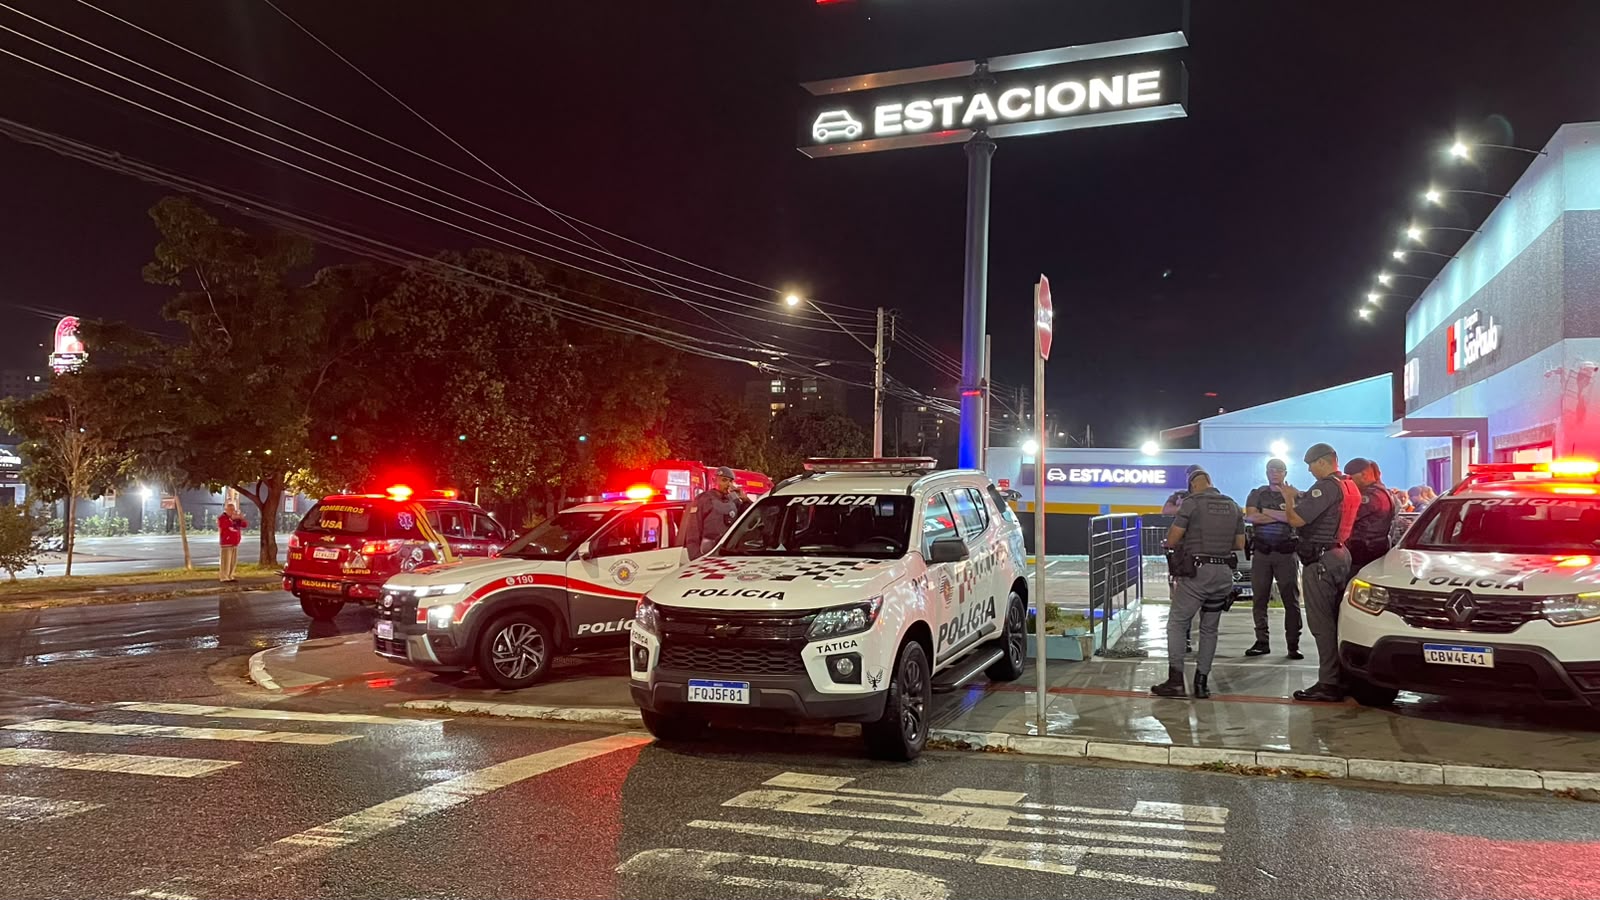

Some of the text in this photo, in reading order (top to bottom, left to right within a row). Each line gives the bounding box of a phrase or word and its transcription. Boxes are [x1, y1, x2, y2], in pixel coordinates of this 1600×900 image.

[873, 70, 1161, 135] ESTACIONE
[1069, 468, 1166, 484] ESTACIONE
[786, 494, 878, 507] POLÍCIA
[319, 505, 365, 514] BOMBEIROS
[320, 519, 343, 530] USA
[516, 574, 534, 585] 190
[936, 595, 996, 654] POLÍCIA
[1430, 650, 1486, 665] CBW4E41
[693, 687, 743, 702] FQJ5F81
